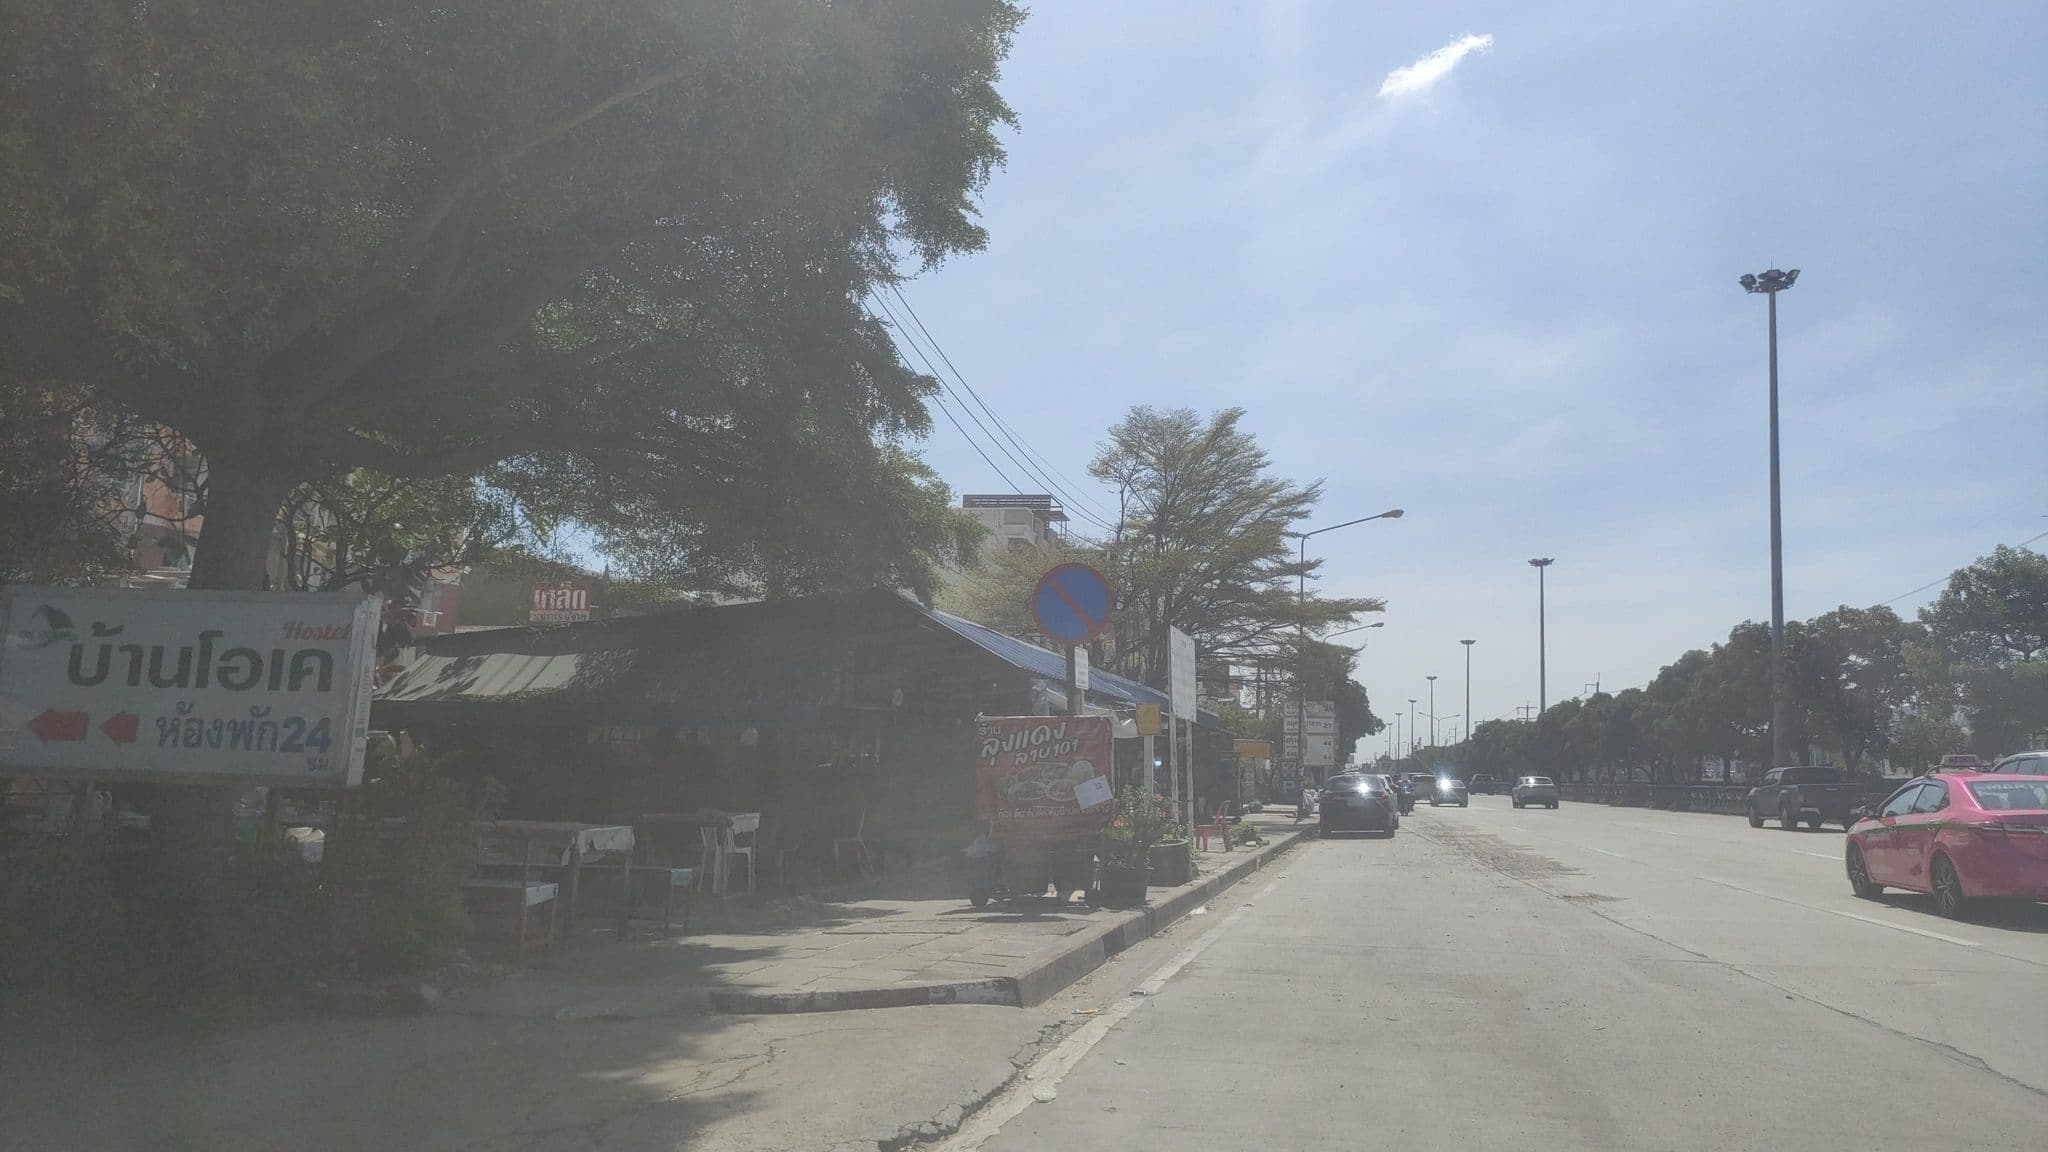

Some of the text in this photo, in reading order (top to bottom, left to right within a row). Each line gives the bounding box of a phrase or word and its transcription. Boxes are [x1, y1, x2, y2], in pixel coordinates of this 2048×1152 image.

[282, 620, 350, 640] Hostel
[67, 621, 334, 692] บ้านโอเค
[982, 722, 1066, 766] ลุงแดง
